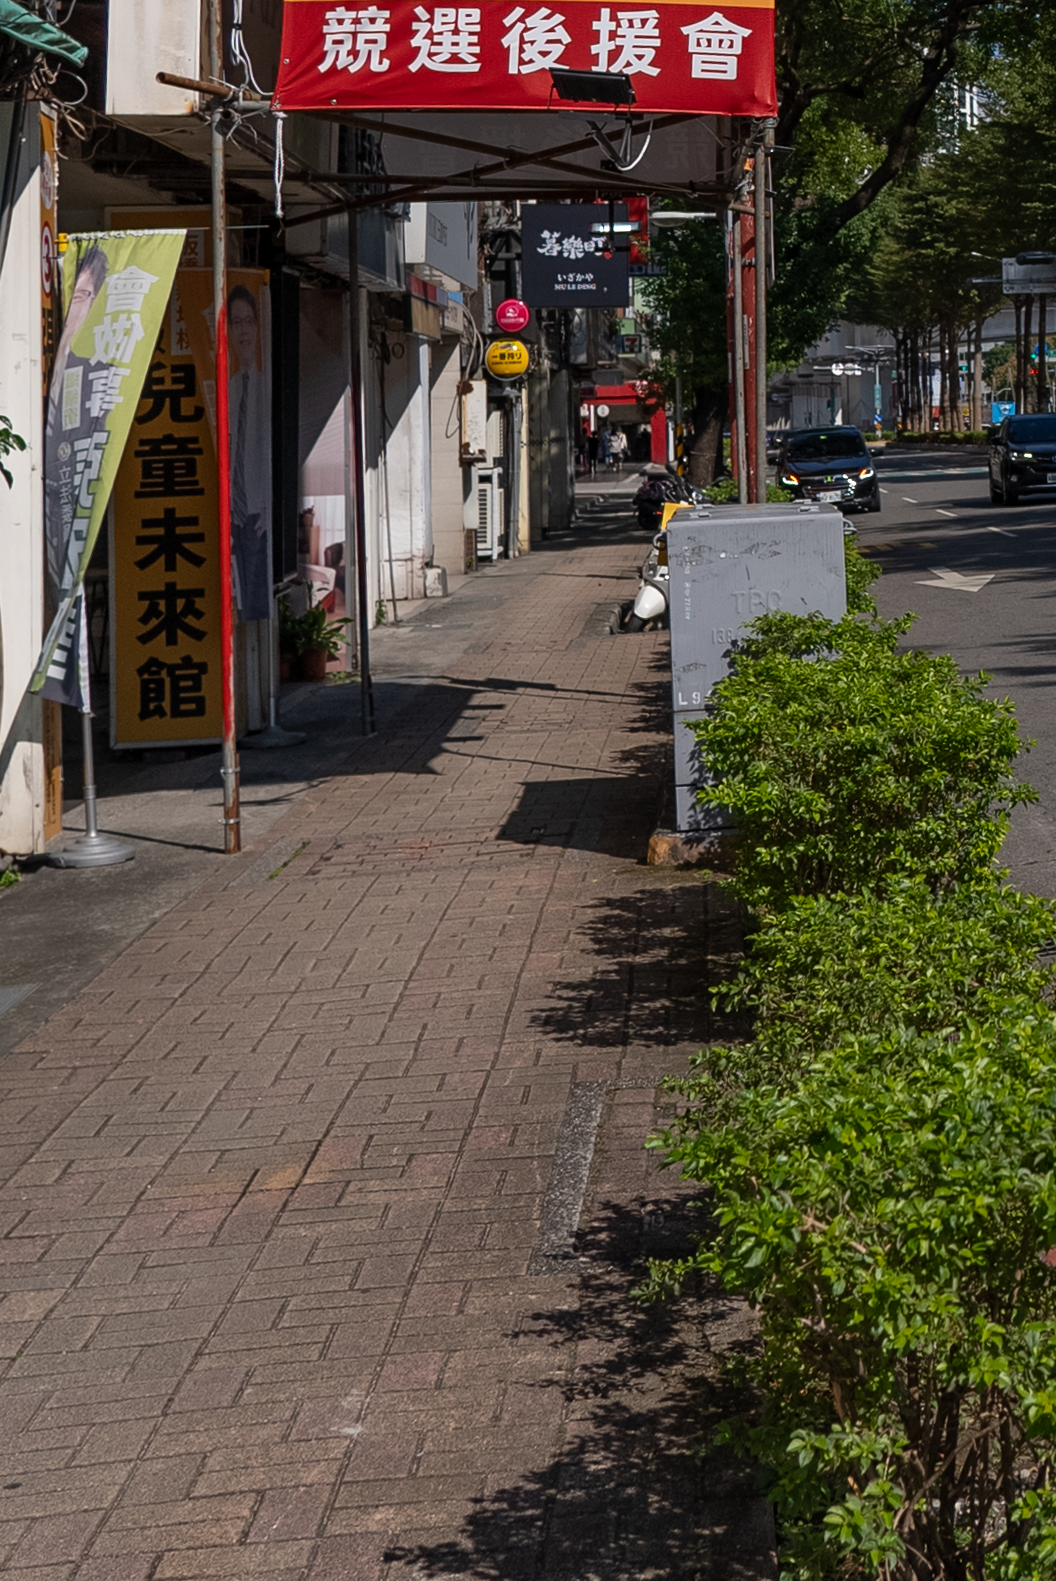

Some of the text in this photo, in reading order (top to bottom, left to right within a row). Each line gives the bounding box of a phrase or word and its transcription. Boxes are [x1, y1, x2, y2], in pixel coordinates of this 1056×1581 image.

[316, 4, 753, 81] 競選後援會
[134, 331, 207, 721] 兒童未來館
